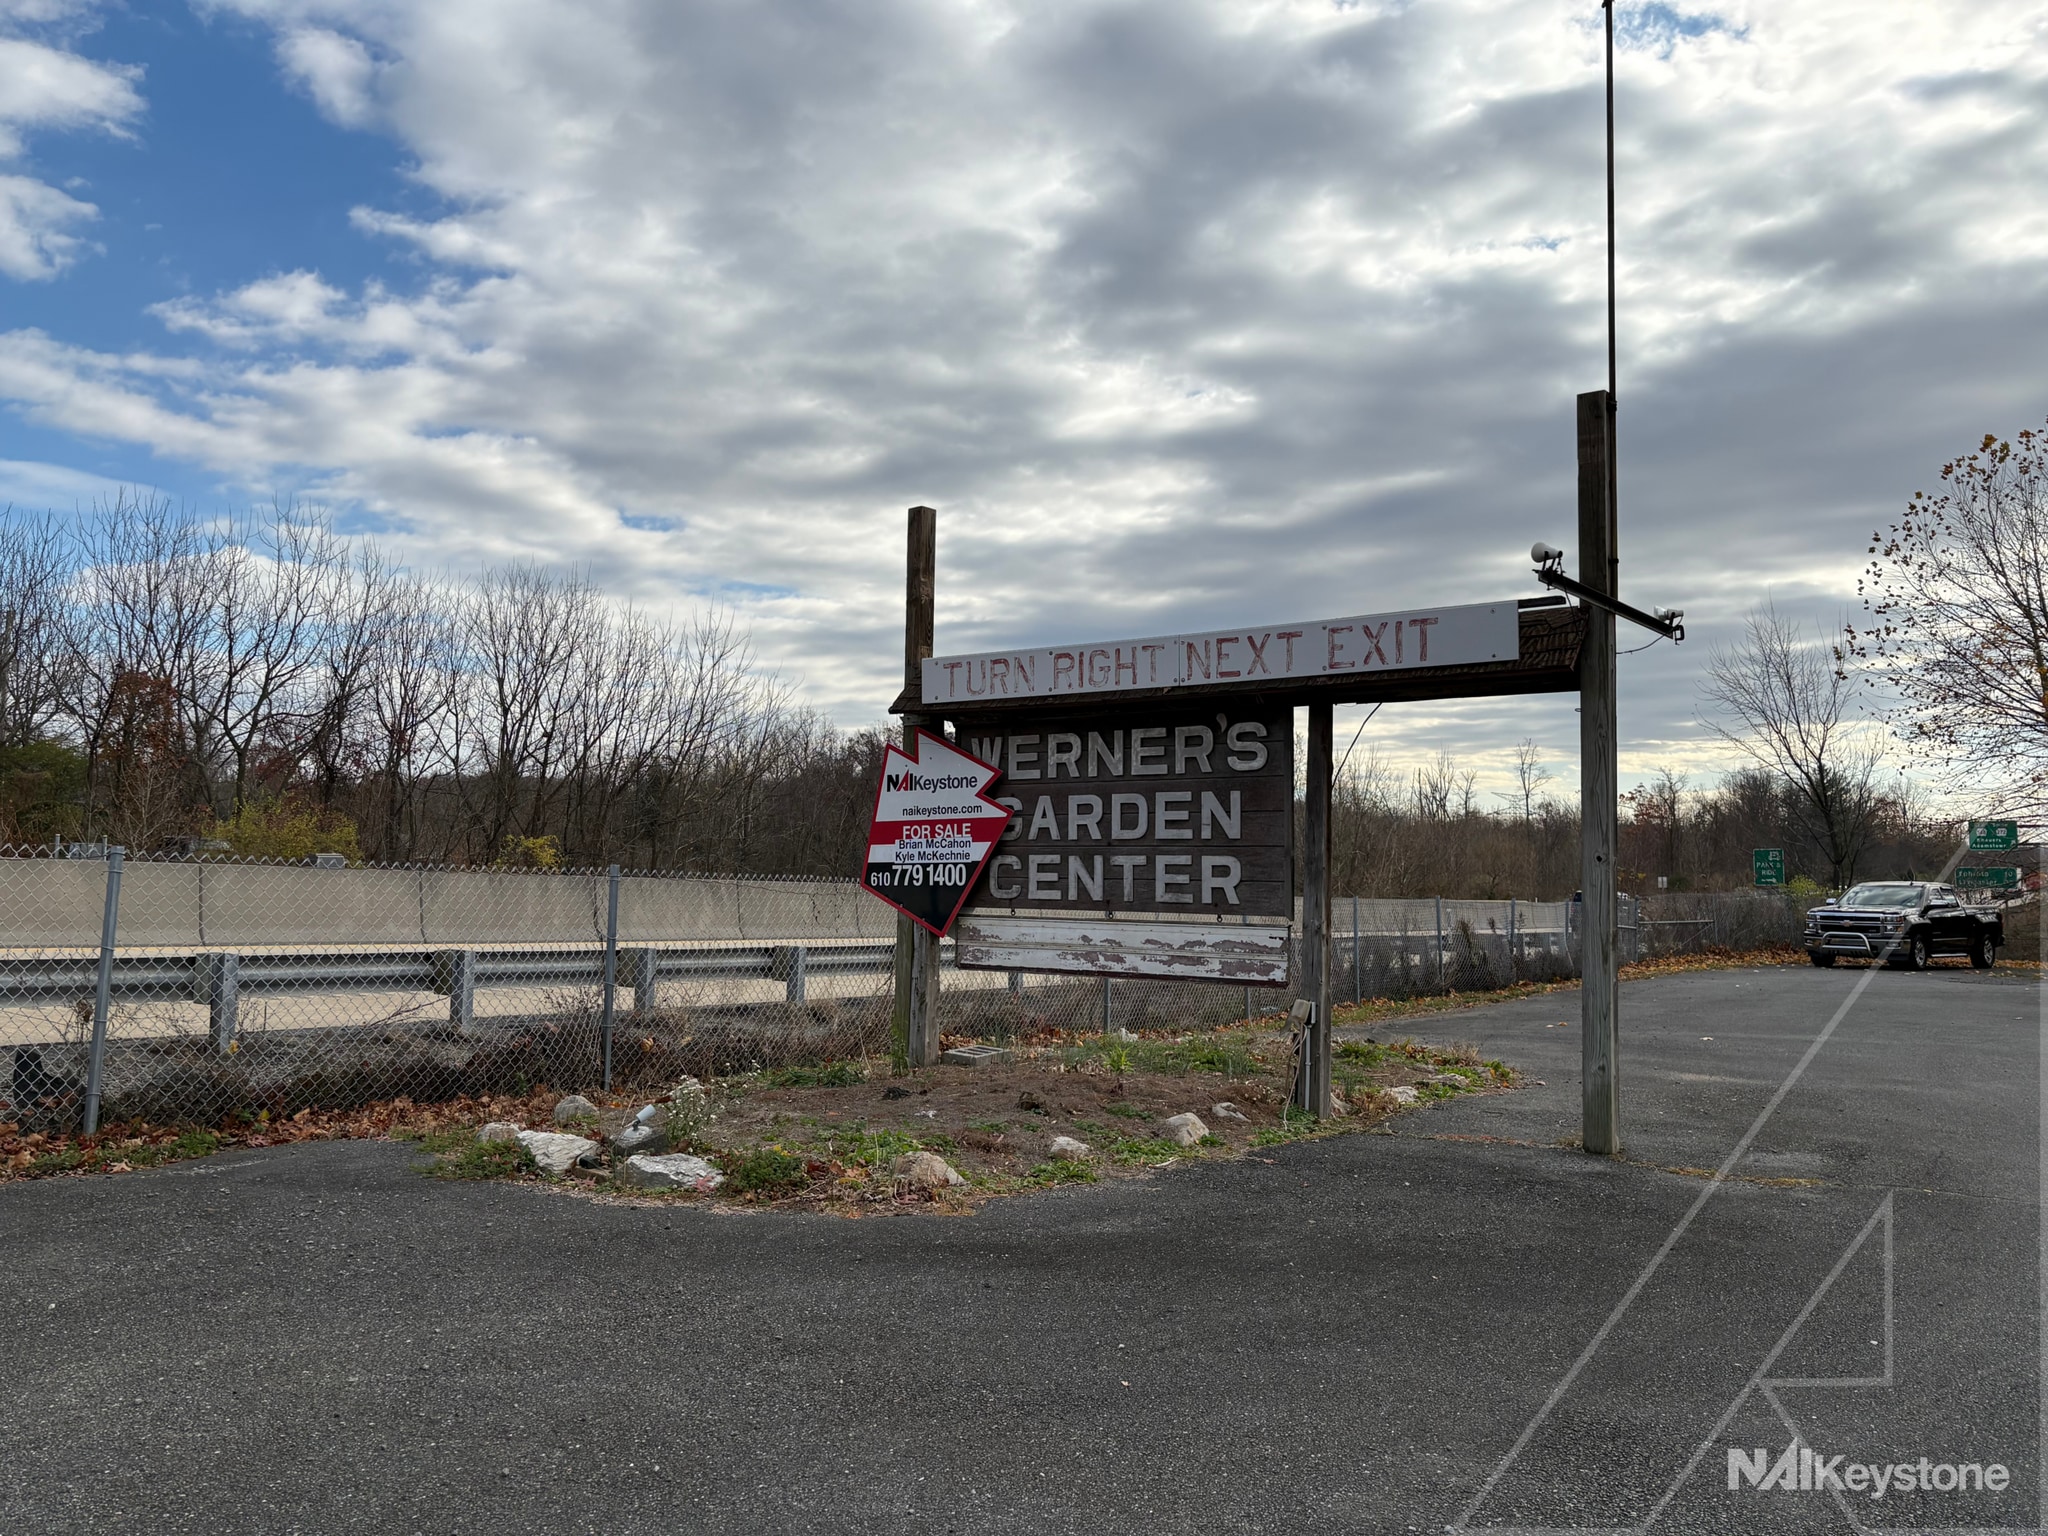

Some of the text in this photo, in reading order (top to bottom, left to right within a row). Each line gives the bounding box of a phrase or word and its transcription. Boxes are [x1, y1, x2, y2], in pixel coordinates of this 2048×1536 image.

[943, 617, 1439, 699] TURN RIGHT NEXT EXIT
[970, 713, 1268, 781] WERNER'S
[902, 804, 983, 818] naikeystone.com
[903, 823, 972, 840] FOR SALE
[898, 839, 971, 850] Brian McCahon
[895, 851, 971, 864] Kyle McKechnie
[870, 863, 967, 887] 610 779 1400
[989, 854, 1242, 905] CENTER
